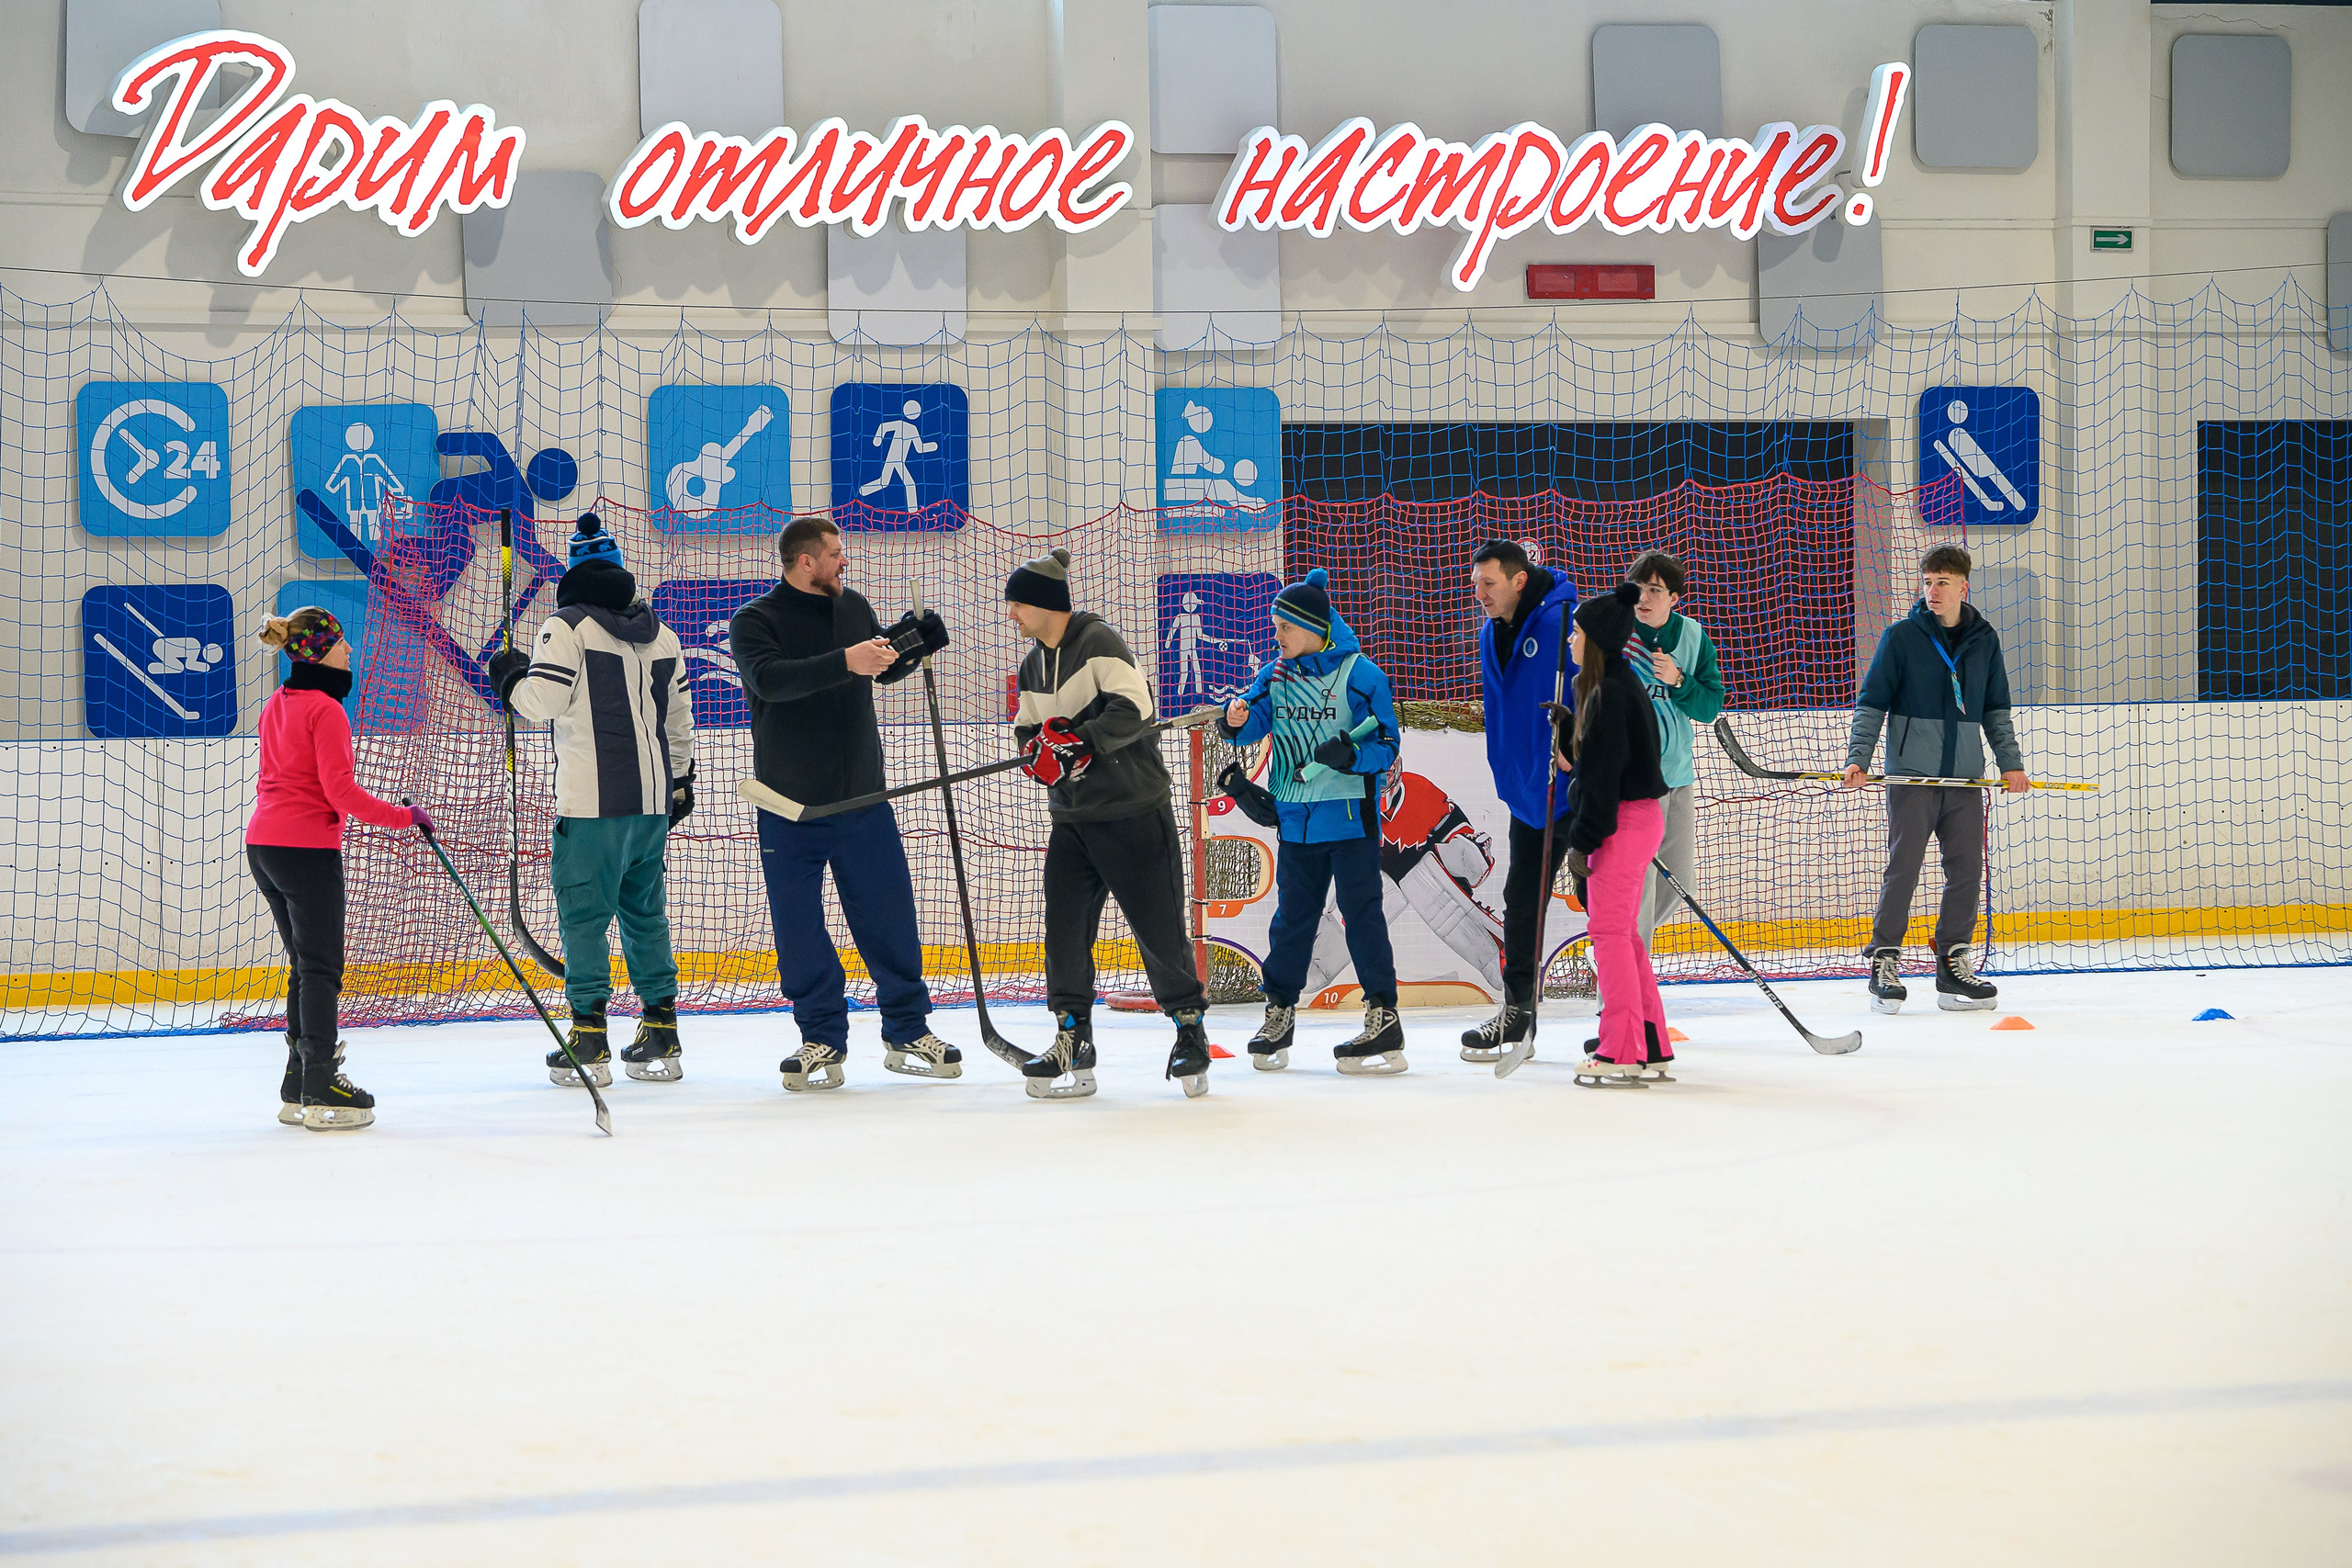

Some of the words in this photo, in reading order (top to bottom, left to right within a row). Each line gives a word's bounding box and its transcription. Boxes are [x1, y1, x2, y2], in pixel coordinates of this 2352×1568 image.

[122, 39, 516, 267] Дарим
[618, 123, 1126, 236] отличное
[1225, 71, 1904, 284] настроение!
[164, 440, 221, 479] 24
[1275, 705, 1338, 722] СУДЬЯ
[1216, 800, 1227, 812] 9
[1218, 904, 1227, 916] 7
[1323, 991, 1339, 1004] 10
